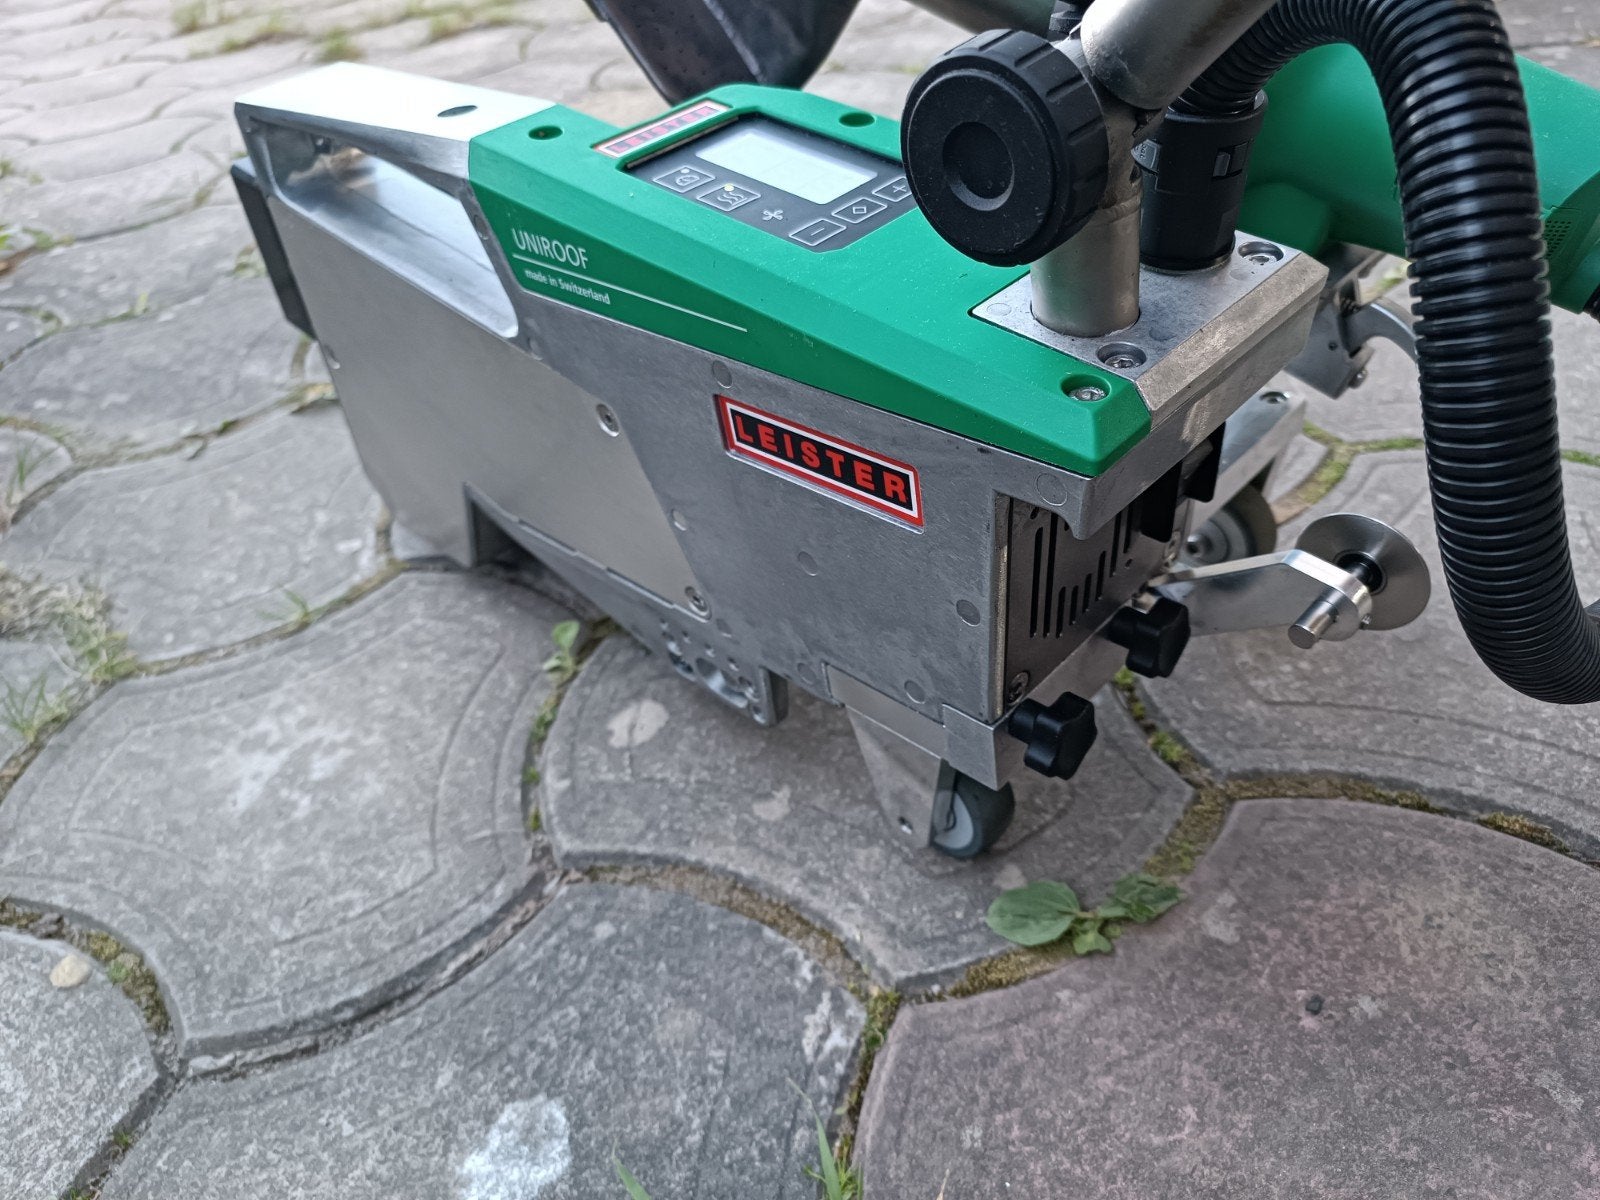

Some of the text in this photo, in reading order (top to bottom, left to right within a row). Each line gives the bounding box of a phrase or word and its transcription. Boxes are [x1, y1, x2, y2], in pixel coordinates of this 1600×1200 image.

[511, 228, 588, 270] UNIROOF
[525, 269, 611, 305] made in Switzerland
[735, 414, 908, 503] LEISTER
